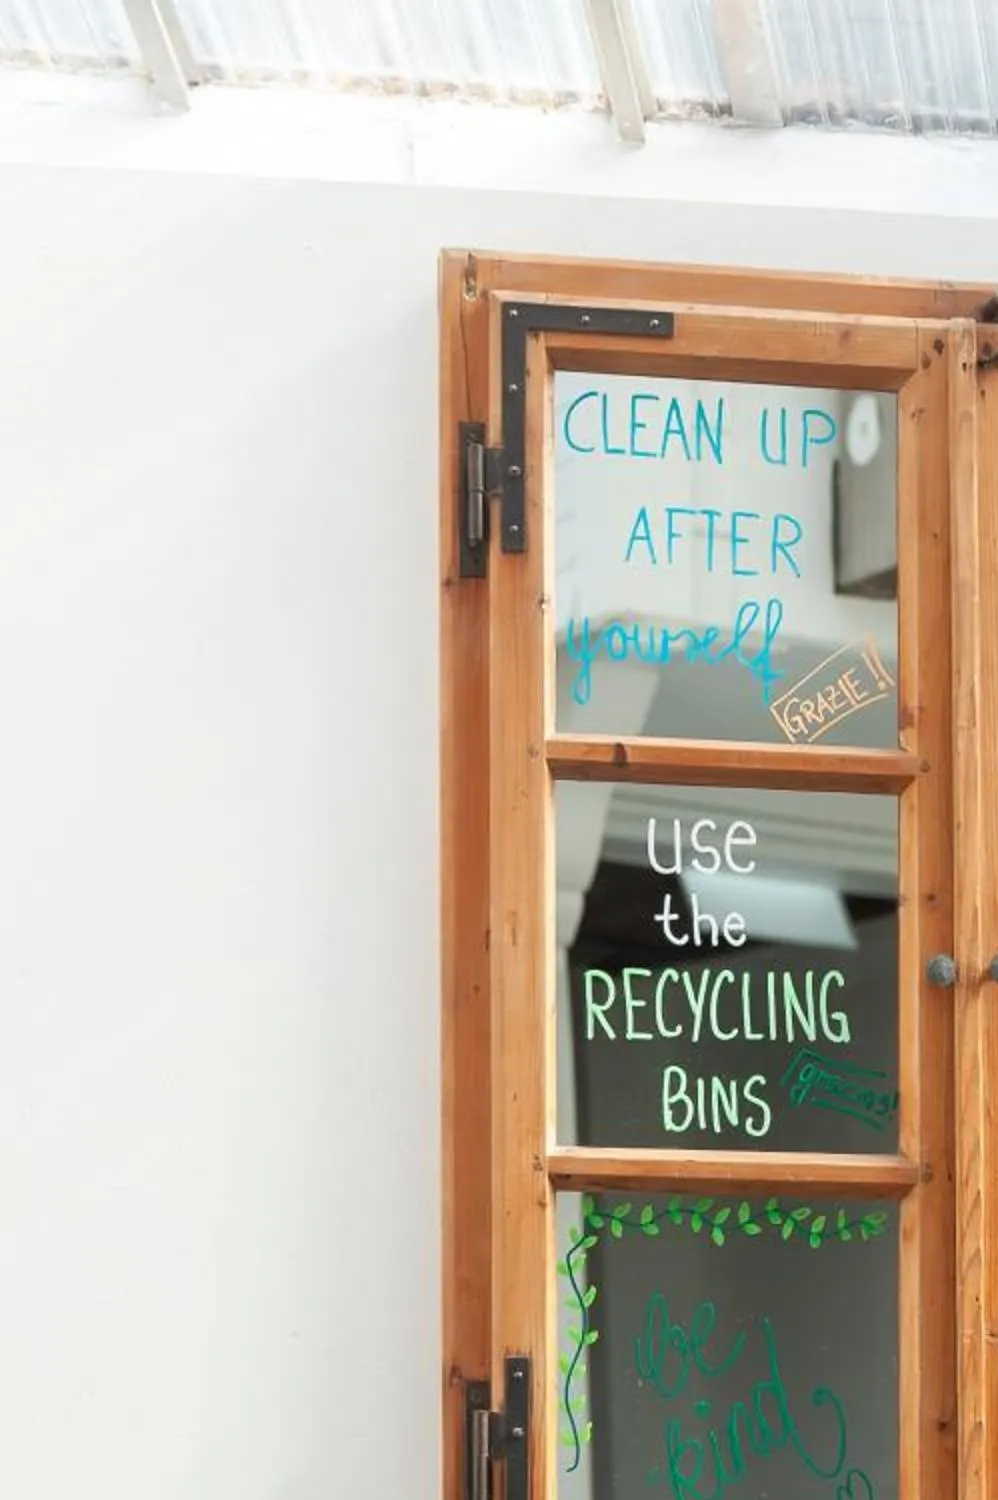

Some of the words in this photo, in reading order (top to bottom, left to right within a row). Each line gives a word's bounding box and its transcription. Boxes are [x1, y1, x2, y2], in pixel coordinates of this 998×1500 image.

[563, 391, 724, 465] CLEAN
[760, 407, 837, 468] UP
[625, 505, 802, 578] AFTER
[566, 598, 784, 705] yourself
[647, 818, 757, 876] use
[654, 894, 748, 947] the
[584, 967, 851, 1044] RECYCLING
[662, 1065, 772, 1137] BINS
